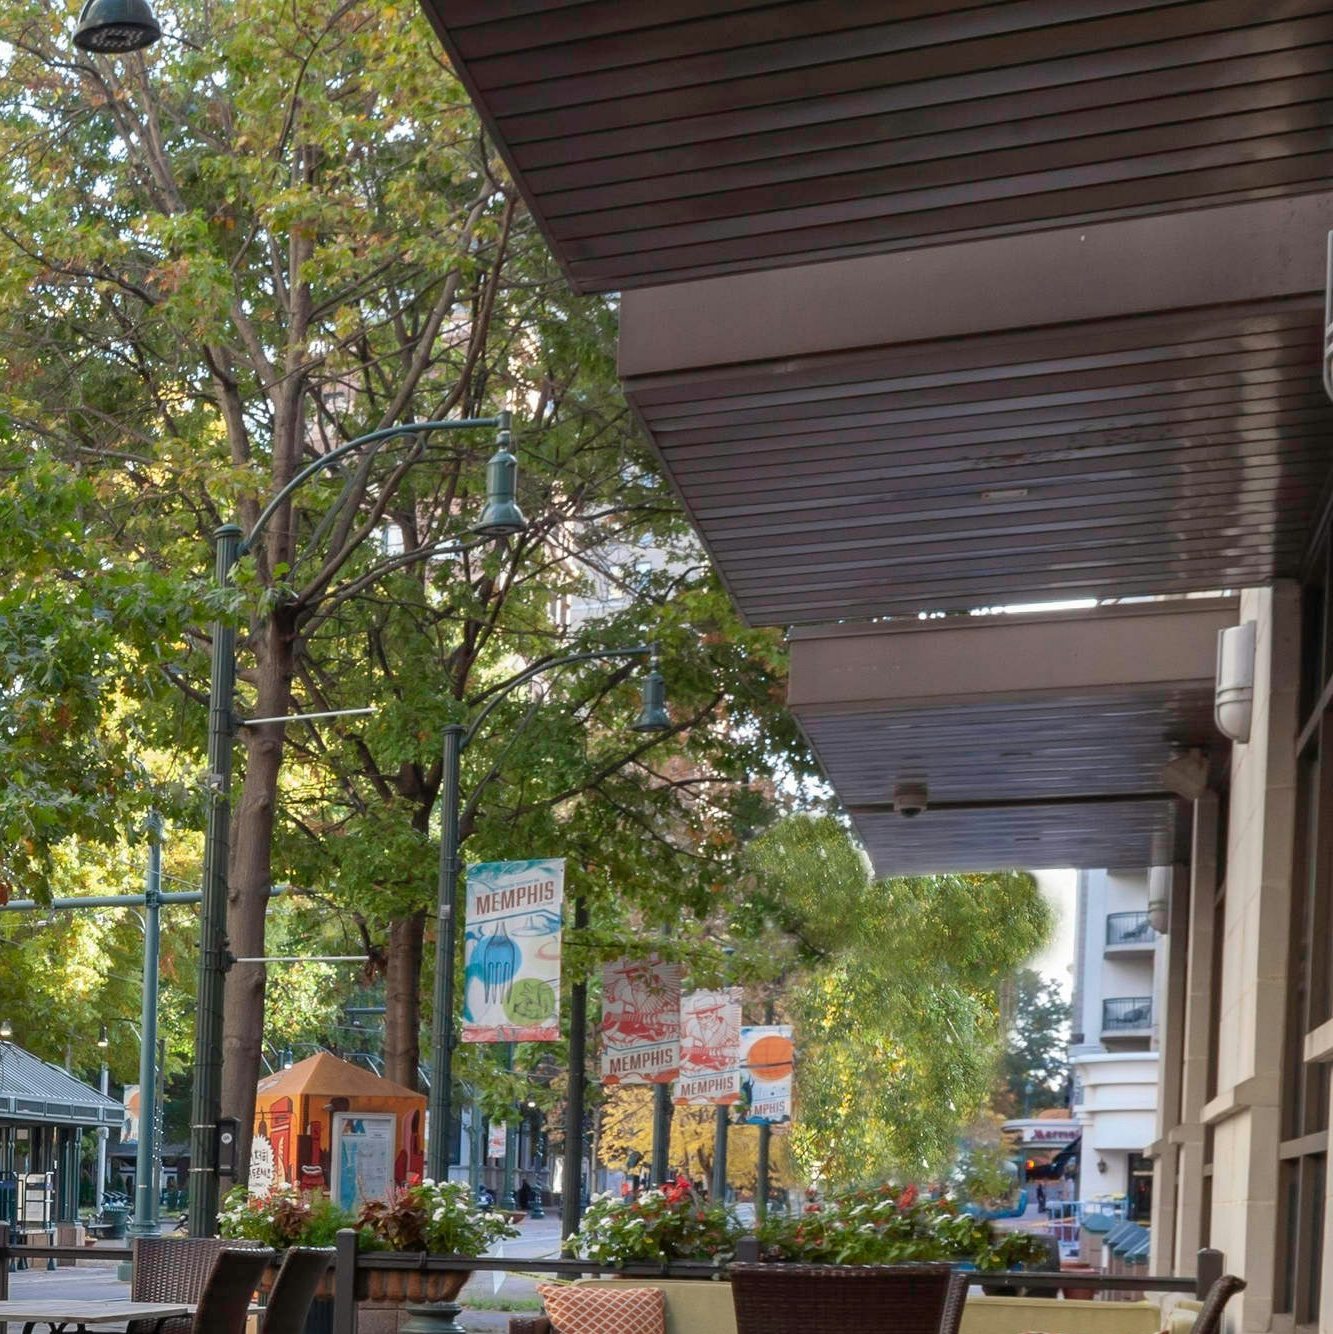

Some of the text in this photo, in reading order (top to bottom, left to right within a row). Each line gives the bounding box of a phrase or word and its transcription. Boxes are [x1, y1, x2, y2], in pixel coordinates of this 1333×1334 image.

[476, 880, 555, 915] MEMPHIS
[609, 1048, 673, 1074] MEMPHIS
[680, 1076, 734, 1096] MEMPHIS
